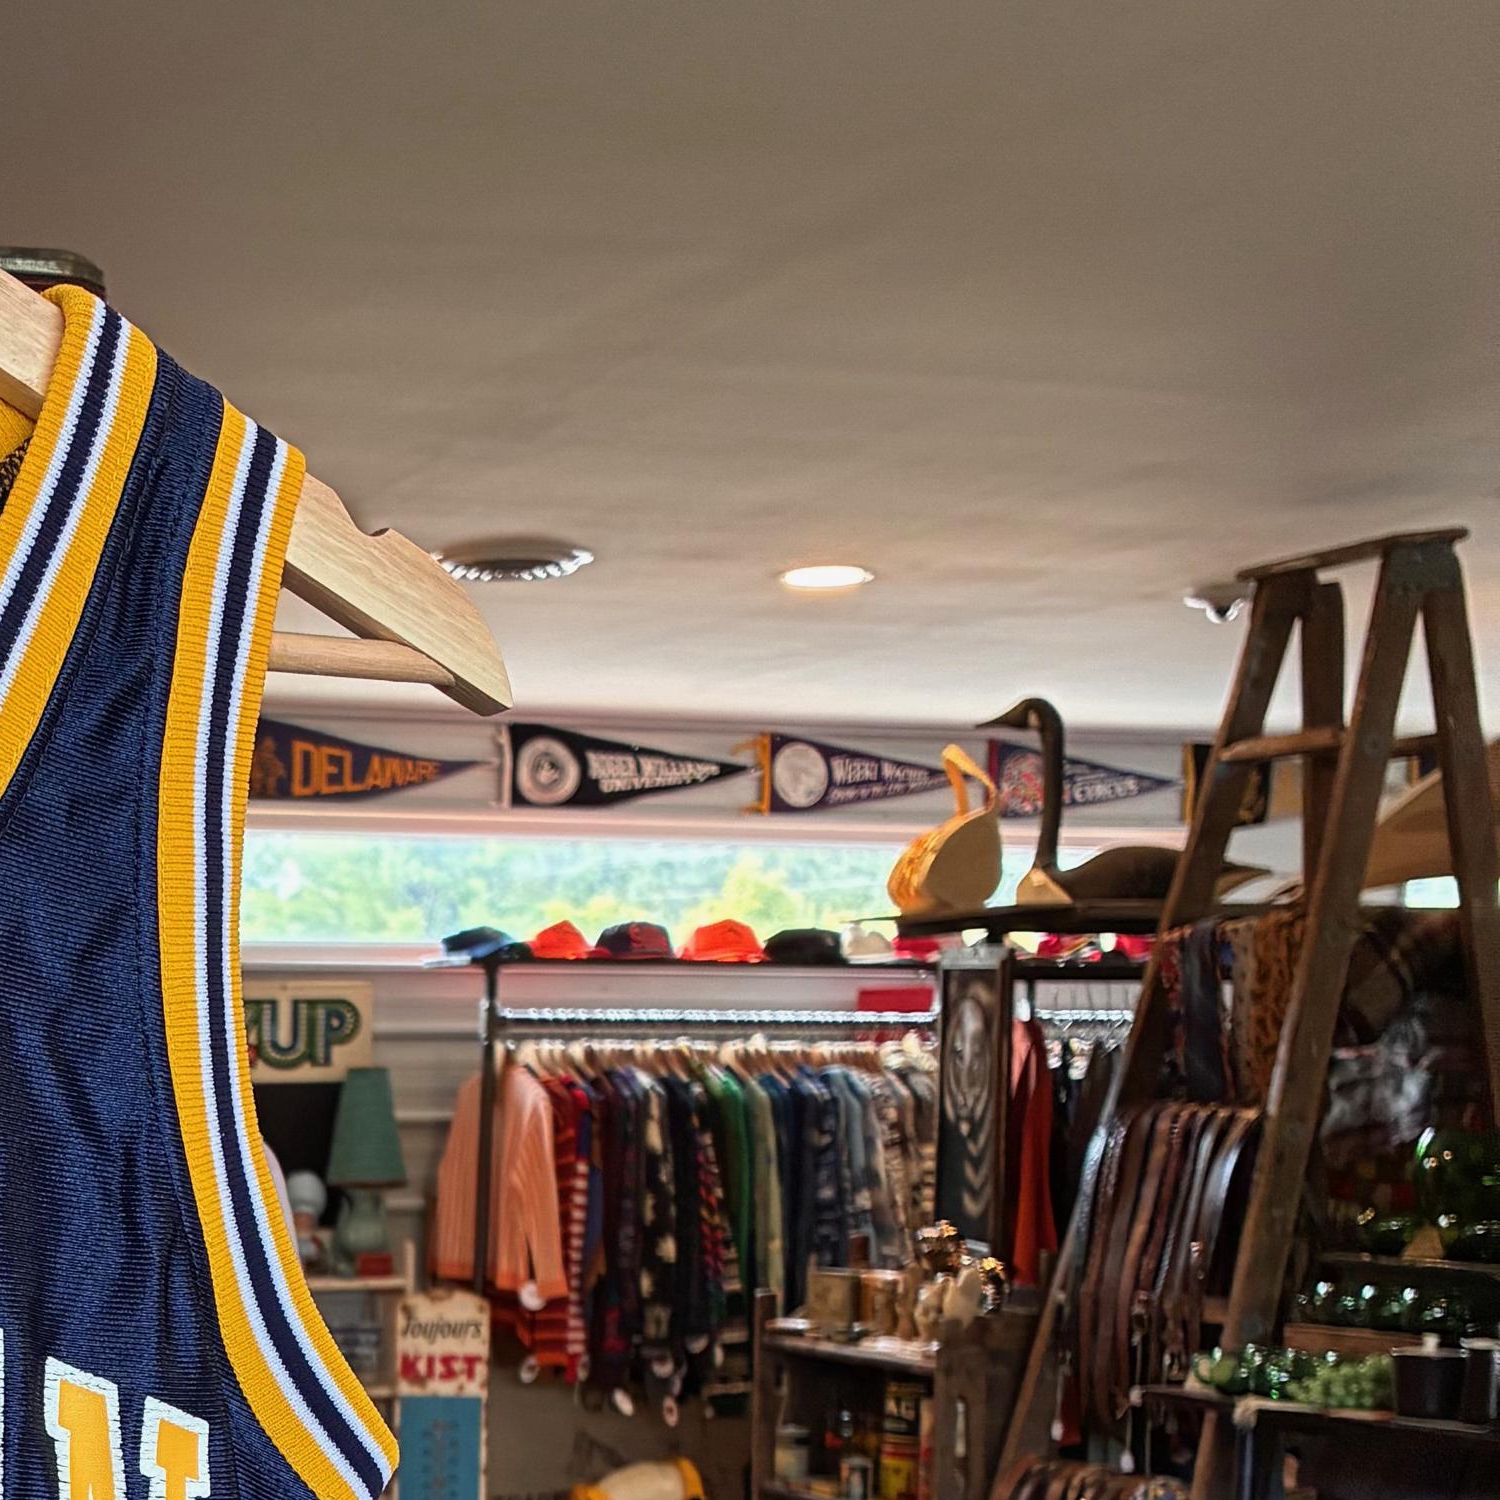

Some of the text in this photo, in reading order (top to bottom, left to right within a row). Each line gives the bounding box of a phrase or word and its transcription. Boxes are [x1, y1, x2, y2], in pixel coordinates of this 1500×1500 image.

[291, 740, 442, 797] DELAWARE
[401, 1312, 483, 1346] Toujours
[399, 1353, 484, 1382] KIST
